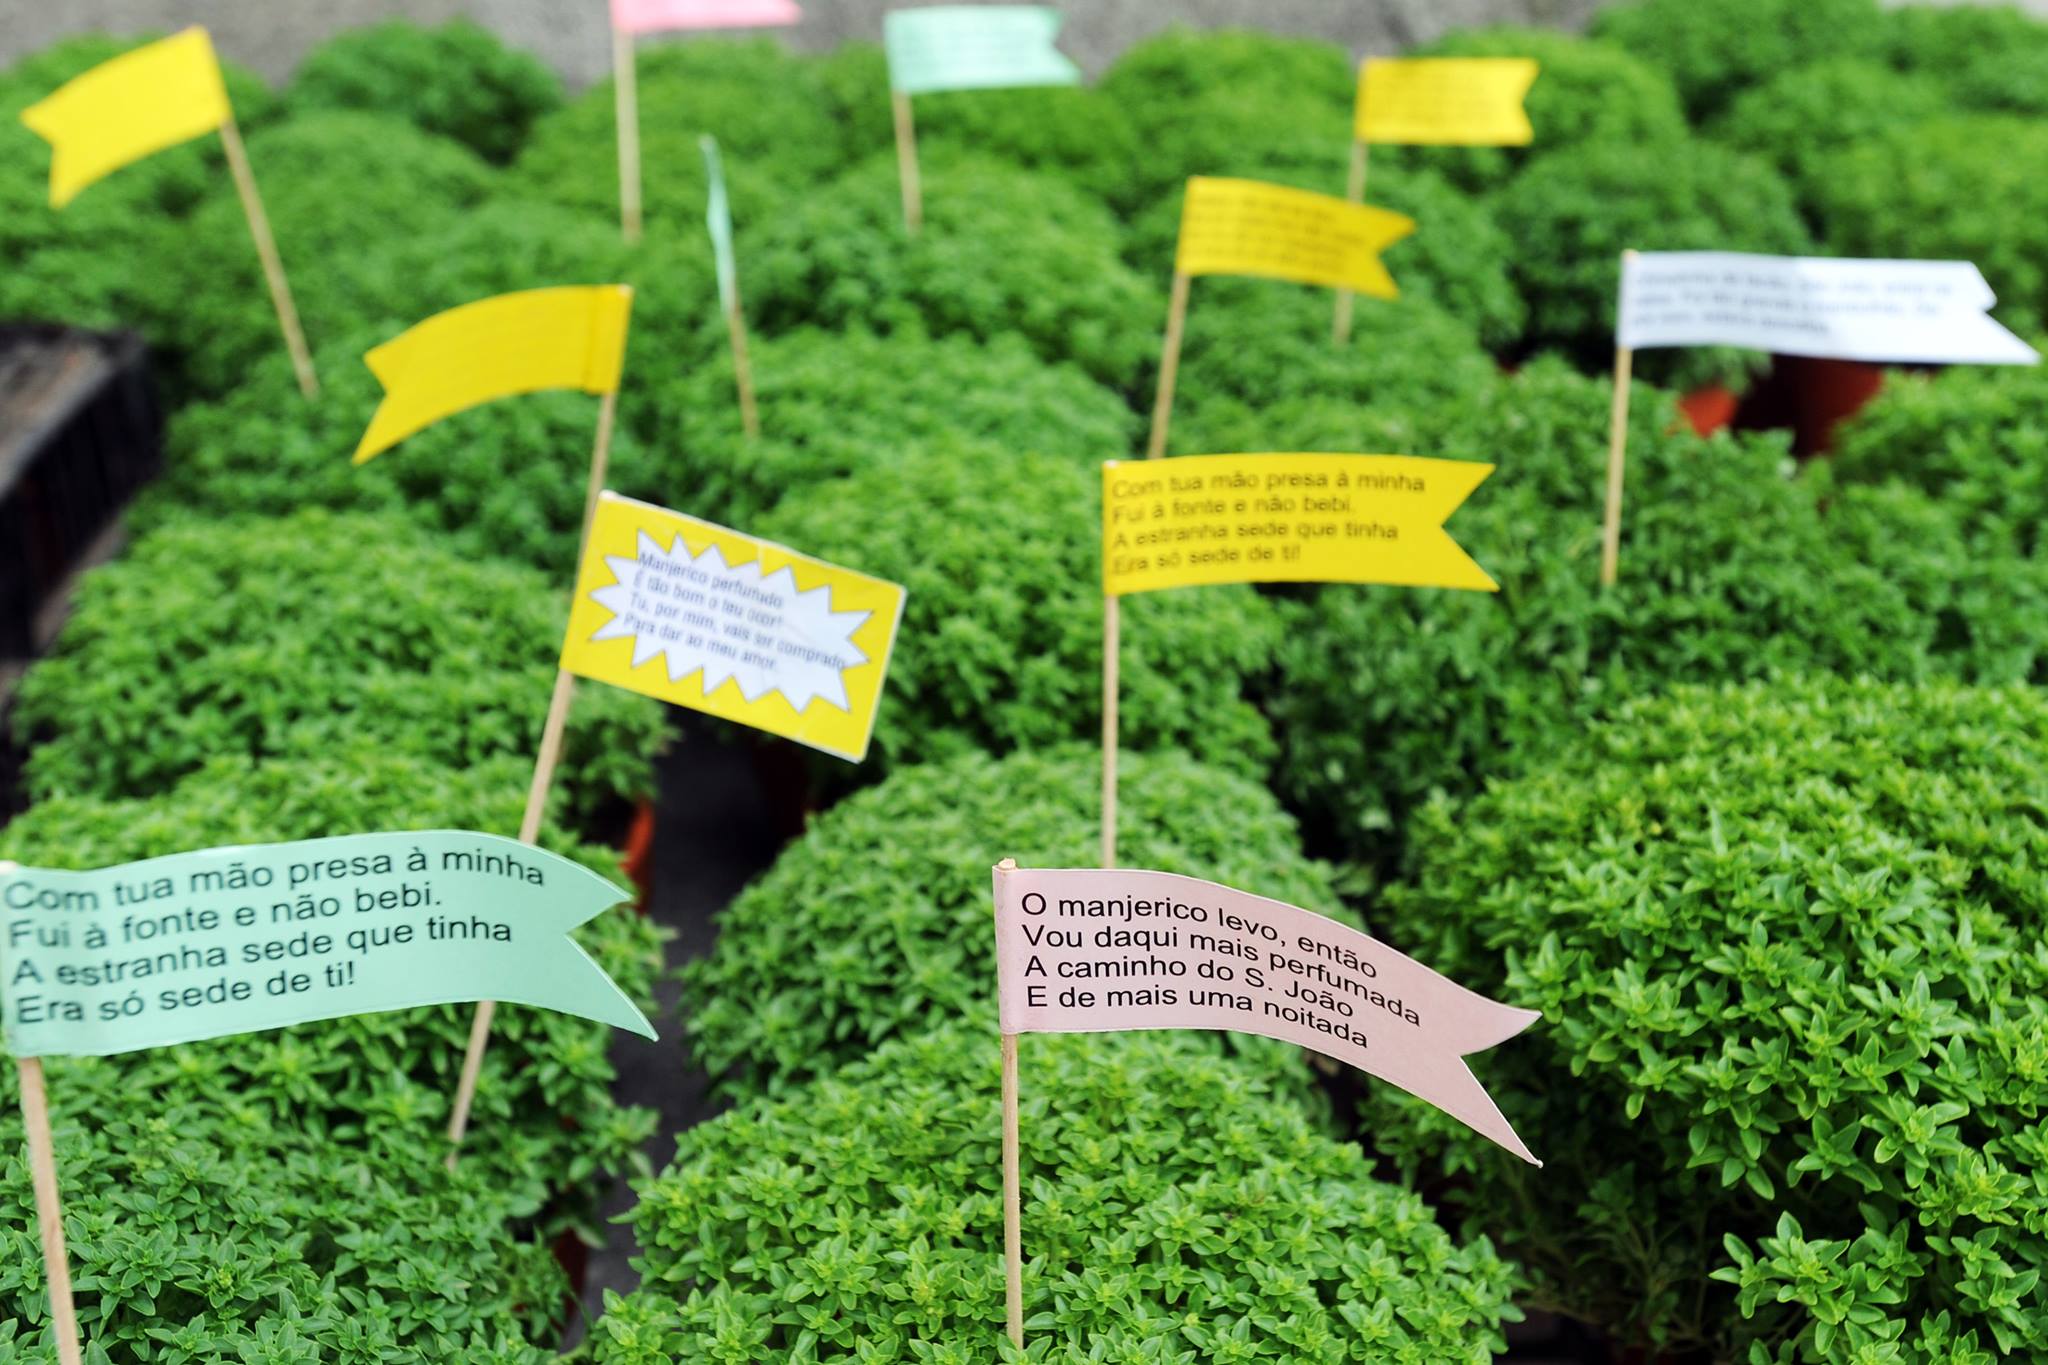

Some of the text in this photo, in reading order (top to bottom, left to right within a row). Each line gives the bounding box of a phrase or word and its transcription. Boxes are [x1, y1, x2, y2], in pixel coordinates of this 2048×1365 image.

[1112, 469, 1425, 497] Com tua mão presa à minha
[1113, 507, 1145, 523] Fui
[1152, 502, 1165, 518] à
[1174, 496, 1225, 514] fonte
[1235, 500, 1246, 512] e
[1254, 496, 1296, 512] não
[1112, 521, 1398, 547] A estranha sede que tinha
[1114, 555, 1148, 574] Era
[1157, 551, 1181, 567] só
[1190, 546, 1240, 563] sede
[1248, 546, 1273, 560] de
[639, 552, 783, 607] Manjerico perfumado
[648, 576, 668, 593] tão
[672, 583, 704, 604] bom
[722, 600, 742, 616] teu
[625, 613, 654, 632] Para
[659, 624, 681, 641] dar
[686, 634, 702, 647] ao
[707, 640, 736, 658] meu
[653, 602, 678, 618] por
[723, 623, 750, 639] vais
[778, 640, 845, 669] comprado
[4, 846, 545, 911] Com tua mão presa à minha
[9, 883, 442, 949] Fui à fonte e não bebi.
[1022, 892, 1377, 978] O manjerico levo, então
[12, 915, 512, 985] A estranha sede que tinha
[1022, 925, 1421, 1027] Vou daqui mais perfumada
[18, 961, 355, 1024] Era só sede de ti!
[1024, 956, 1354, 1018] A caminho do S. João
[1028, 986, 1368, 1048] E de mais uma noitada
